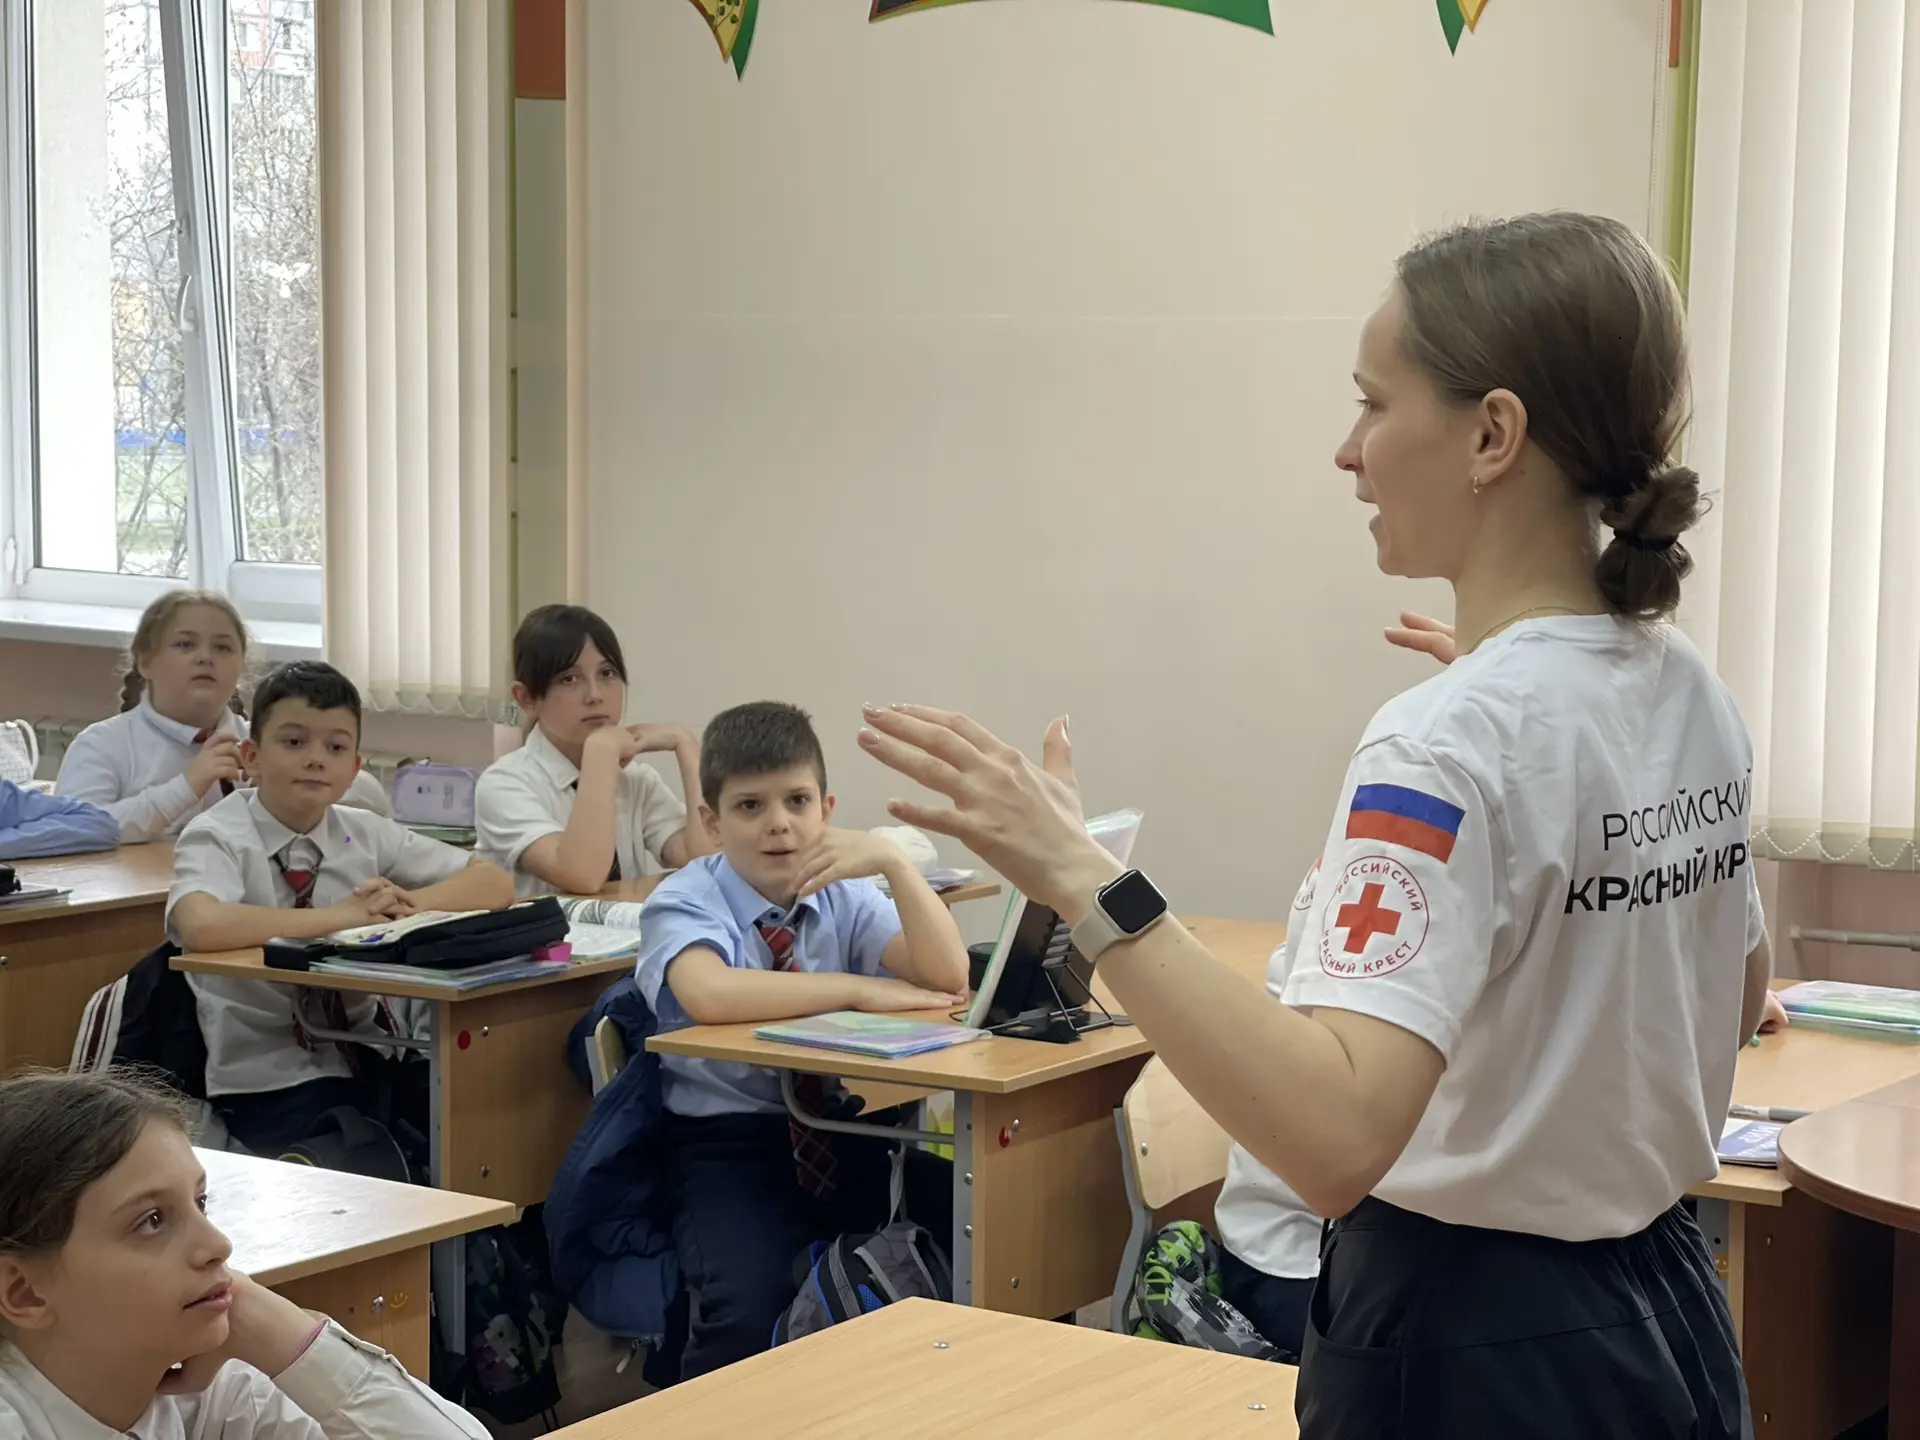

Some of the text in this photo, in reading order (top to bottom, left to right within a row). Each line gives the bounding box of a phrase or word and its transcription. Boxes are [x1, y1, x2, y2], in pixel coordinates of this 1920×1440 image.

[1337, 862, 1423, 911] РОССИЙСКИЙ
[1564, 839, 1749, 914] КРАСНЫЙ КР
[1323, 929, 1412, 973] КРАСНЫЙ КРЕСТ
